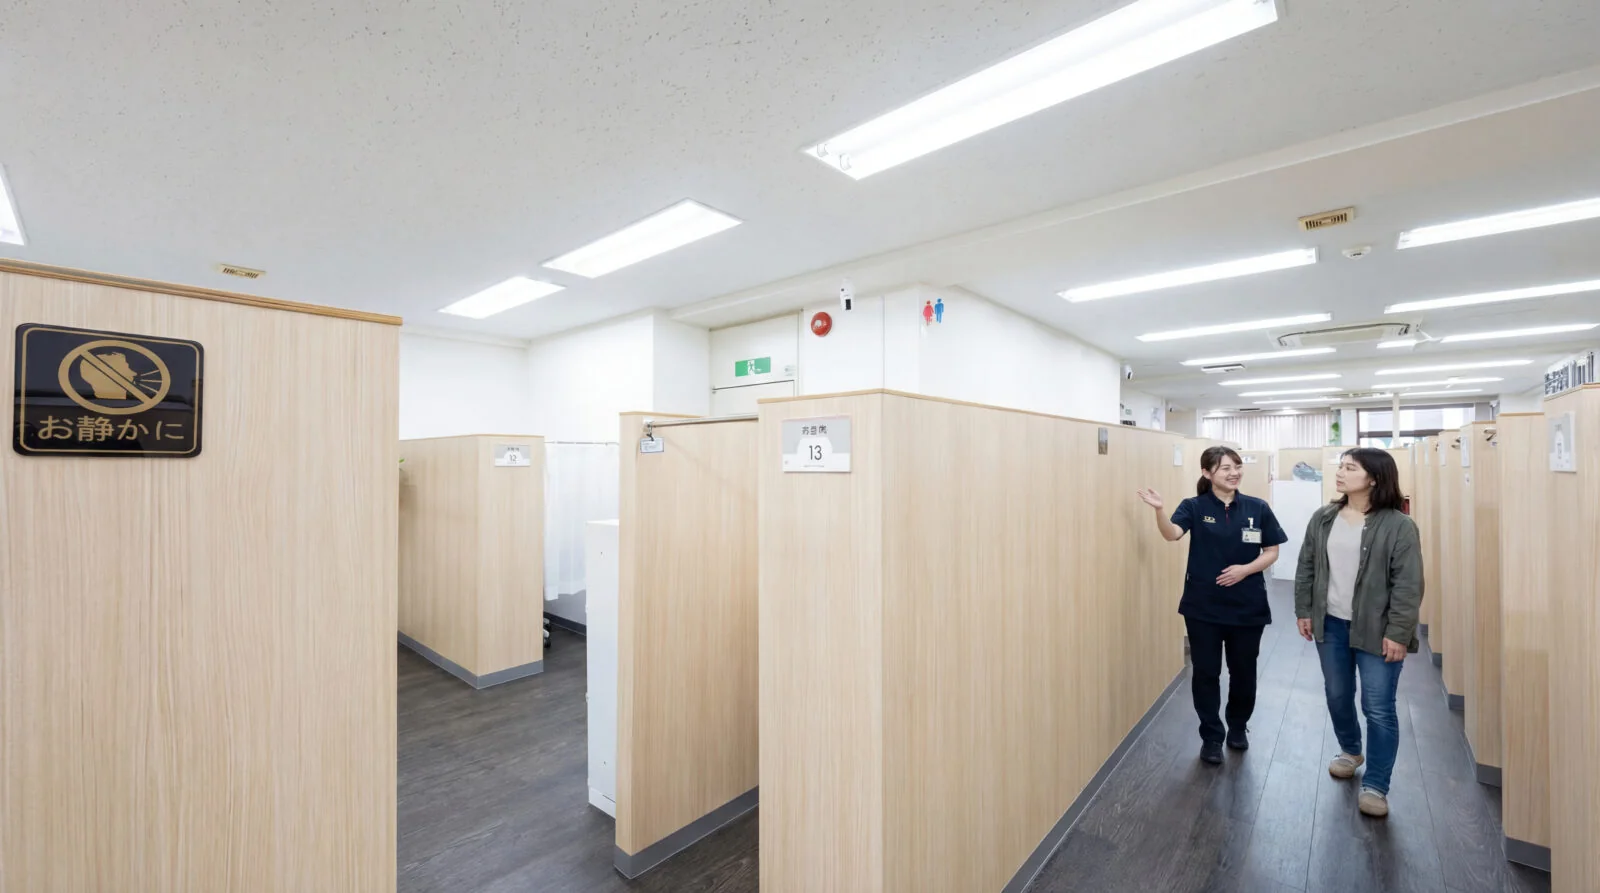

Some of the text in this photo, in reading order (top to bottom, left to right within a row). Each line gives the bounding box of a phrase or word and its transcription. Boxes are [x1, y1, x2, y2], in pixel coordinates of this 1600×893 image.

[37, 415, 185, 443] お静かに
[808, 444, 823, 461] 13
